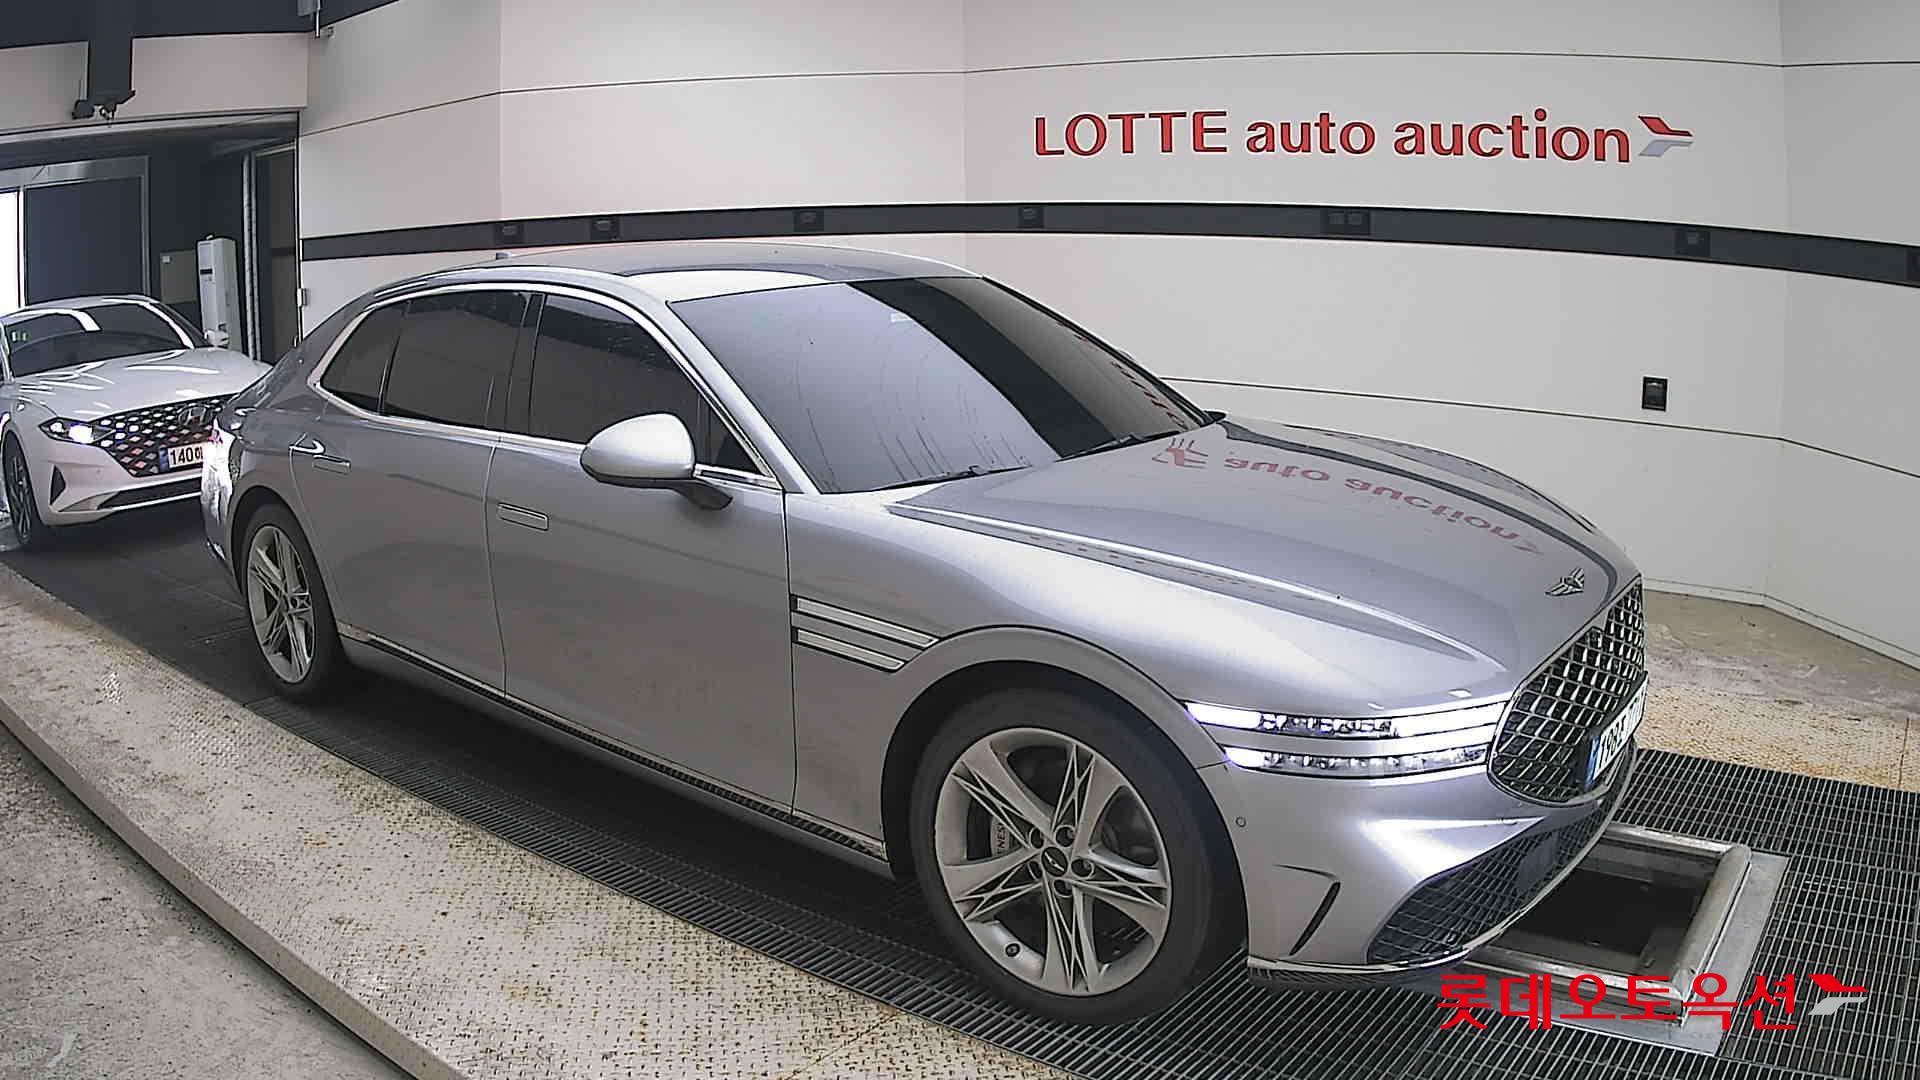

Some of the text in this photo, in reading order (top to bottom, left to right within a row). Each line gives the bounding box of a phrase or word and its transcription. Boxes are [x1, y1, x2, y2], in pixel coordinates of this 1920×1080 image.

[1034, 108, 1631, 163] LOTTE auto auction
